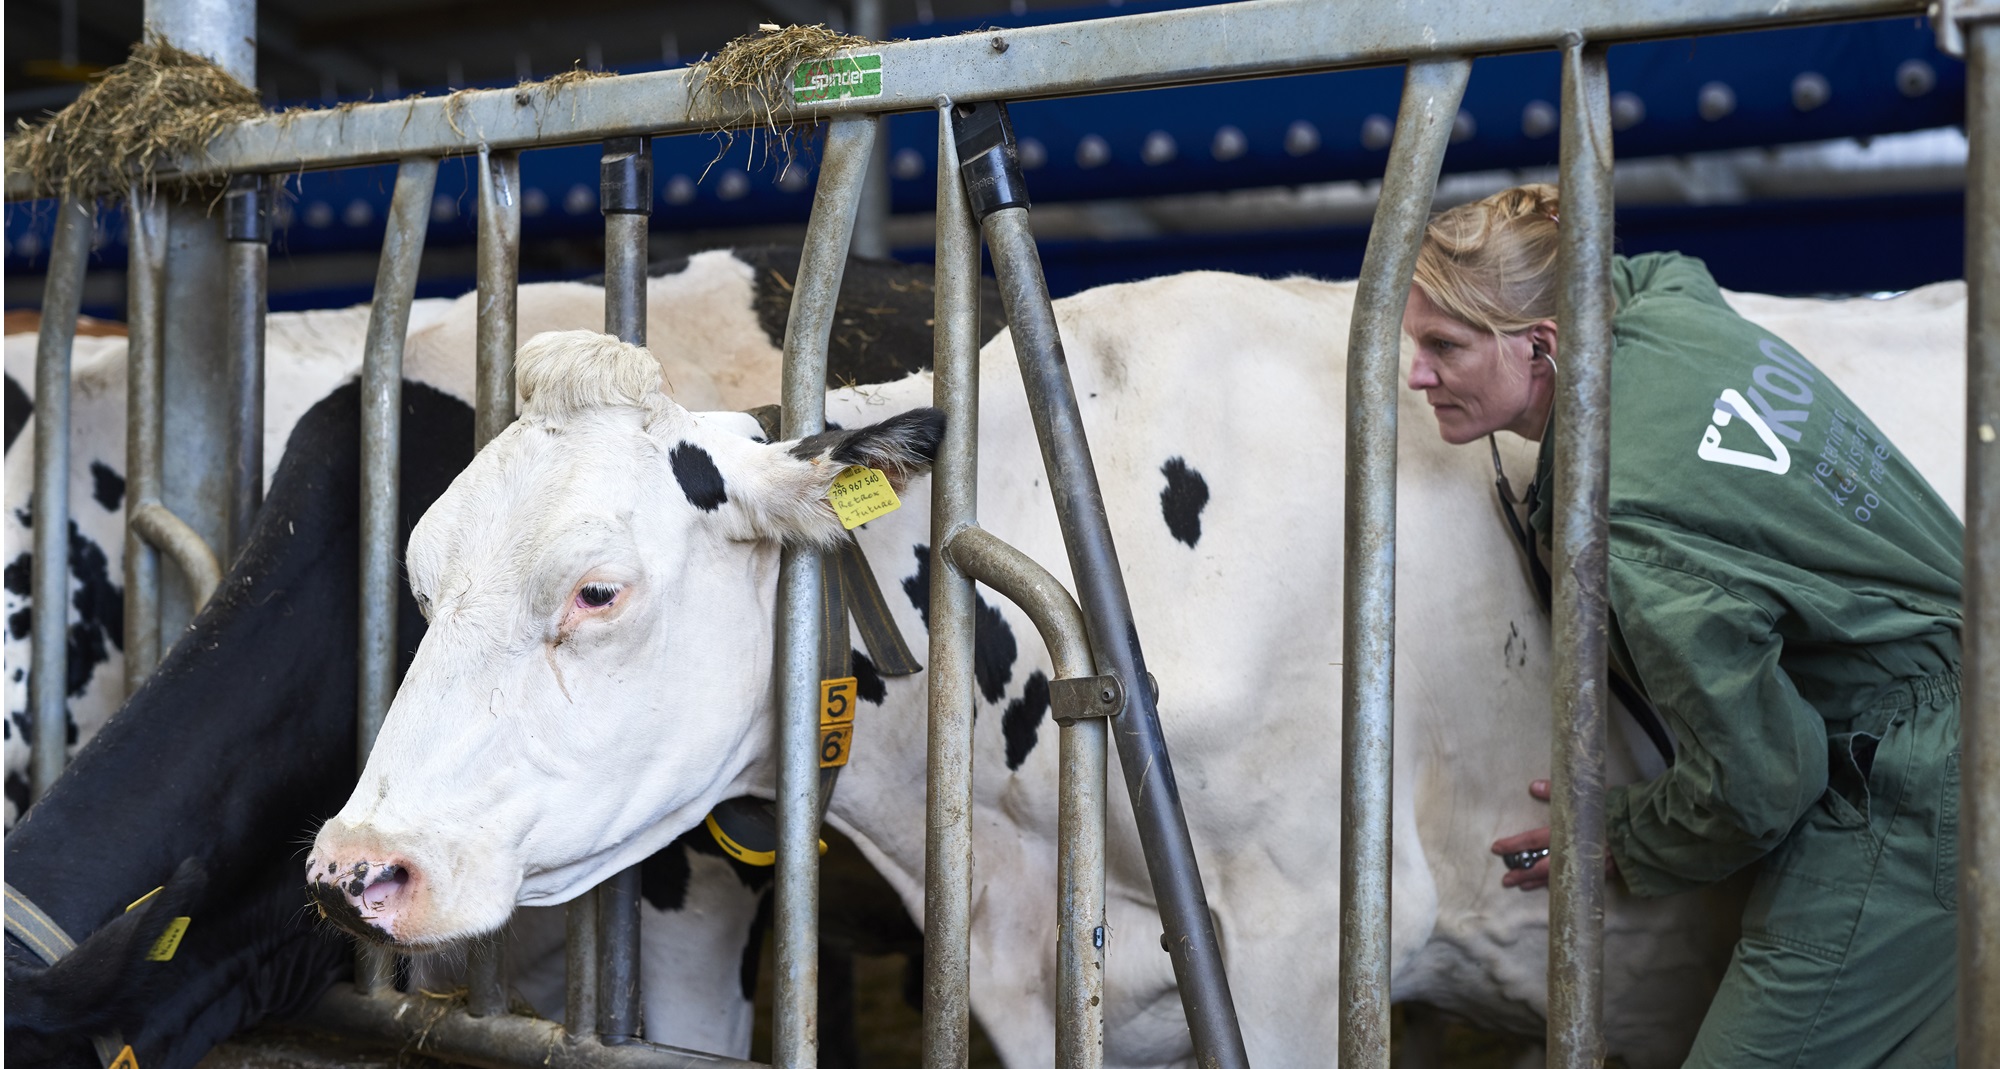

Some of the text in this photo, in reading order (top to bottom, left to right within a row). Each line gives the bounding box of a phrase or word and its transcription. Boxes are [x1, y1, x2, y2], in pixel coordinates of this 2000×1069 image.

[811, 70, 864, 91] spinder
[832, 474, 879, 500] 799 967 540
[827, 684, 848, 718] 5
[821, 730, 843, 762] 6
